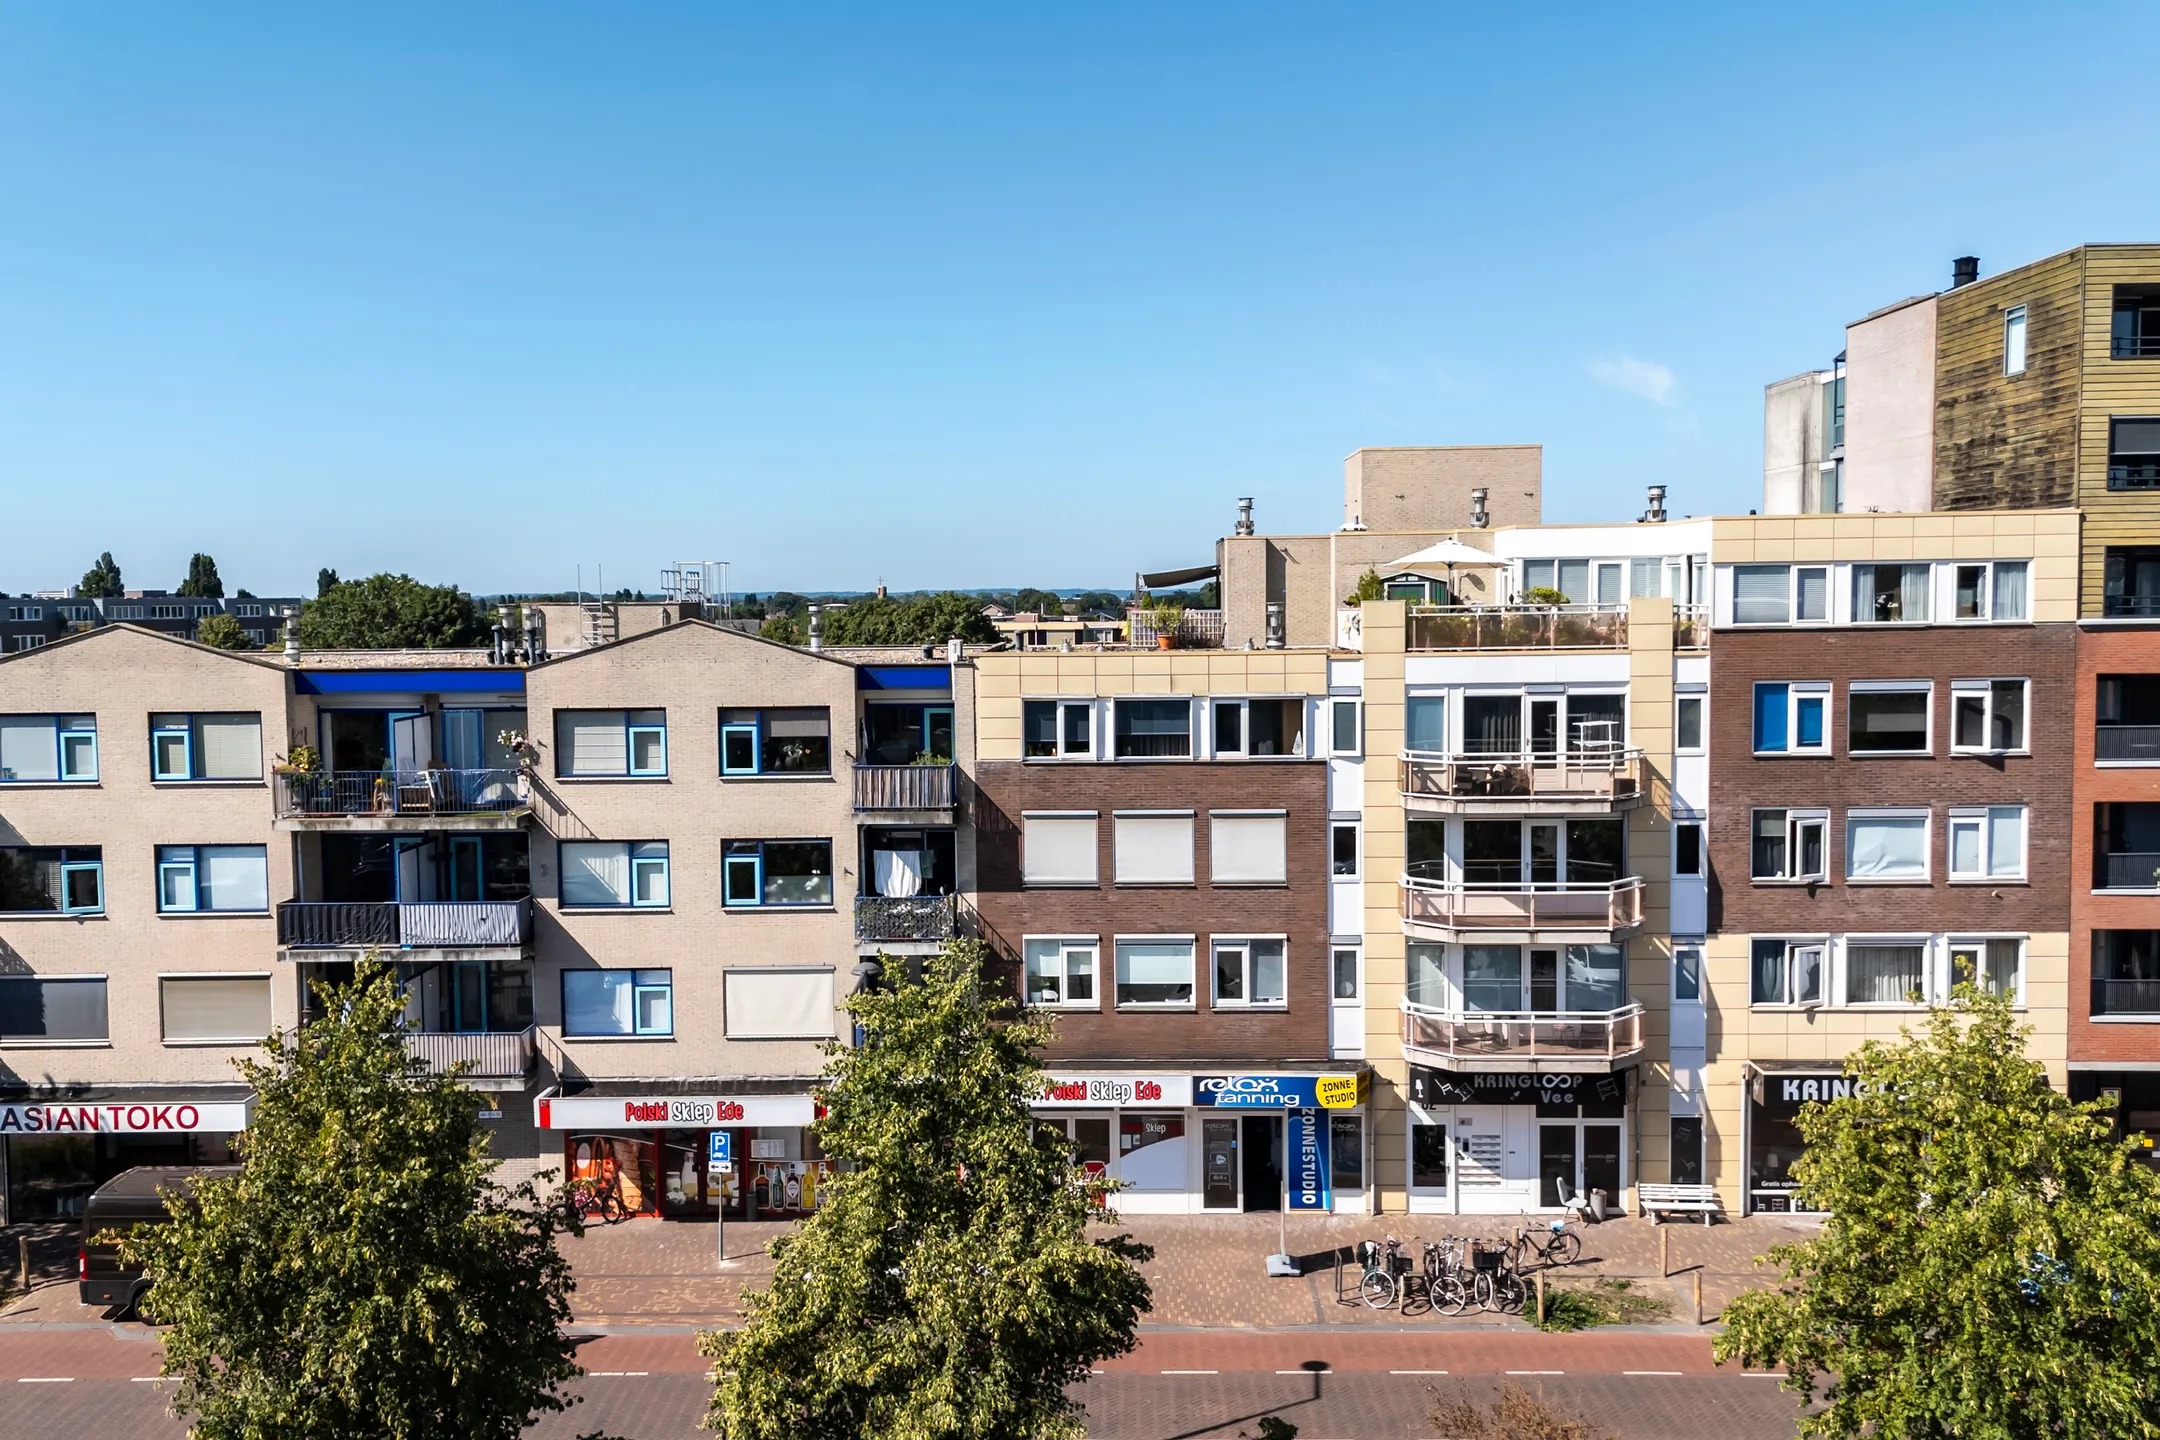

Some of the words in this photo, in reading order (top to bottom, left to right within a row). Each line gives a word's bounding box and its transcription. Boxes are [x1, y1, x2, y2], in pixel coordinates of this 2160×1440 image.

[1322, 1080, 1354, 1093] ZONNE-
[1474, 1074, 1583, 1089] KRINGLOOP
[1091, 1080, 1131, 1104] Sklep
[1135, 1081, 1161, 1101] Ede
[1325, 1091, 1355, 1105] STUDIO
[1540, 1090, 1574, 1104] Vee
[1215, 1092, 1300, 1108] tanning
[0, 1106, 99, 1131] ASIAN
[106, 1105, 199, 1131] TOKO
[625, 1101, 668, 1122] Polski
[672, 1101, 713, 1124] Sklep
[716, 1101, 744, 1121] Ede
[1145, 1123, 1167, 1134] Sklep
[714, 1135, 726, 1150] P
[1301, 1108, 1317, 1204] ZONNESTUDIO
